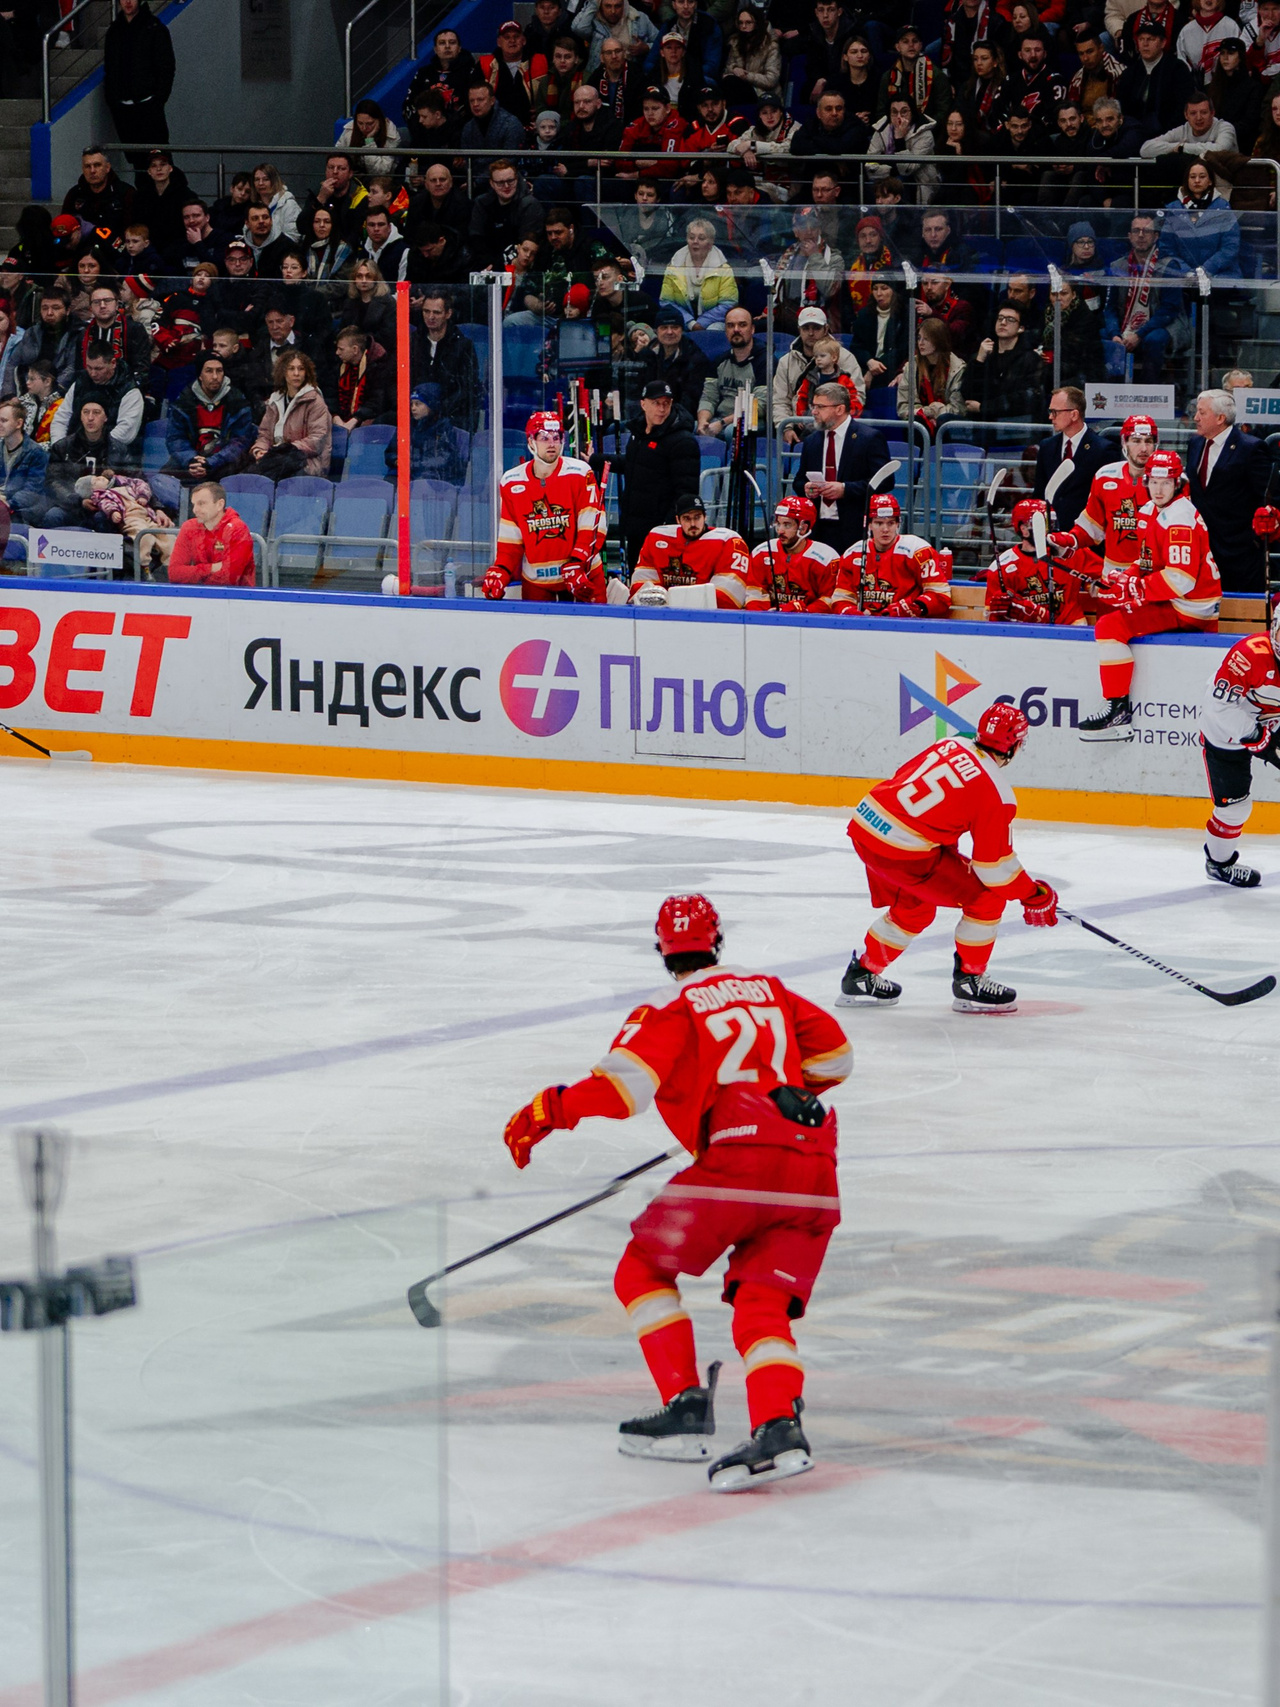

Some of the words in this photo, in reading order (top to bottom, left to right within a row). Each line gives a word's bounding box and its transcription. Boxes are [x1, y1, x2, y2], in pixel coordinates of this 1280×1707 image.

[526, 515, 570, 533] REDSTAR
[1113, 516, 1138, 530] REDS
[50, 545, 115, 561] Ростелеком
[731, 553, 749, 573] 29
[1168, 545, 1191, 565] 86
[536, 567, 562, 578] SIB
[920, 559, 940, 579] 32
[0, 606, 192, 717] BET
[243, 637, 481, 728] Яндекс
[600, 653, 787, 738] Плюс
[1212, 678, 1244, 705] 86
[1129, 700, 1203, 719] истем
[986, 722, 996, 734] 15
[896, 750, 965, 819] 15
[855, 801, 893, 836] SIBUR
[672, 916, 690, 932] 27
[704, 1005, 788, 1085] 27
